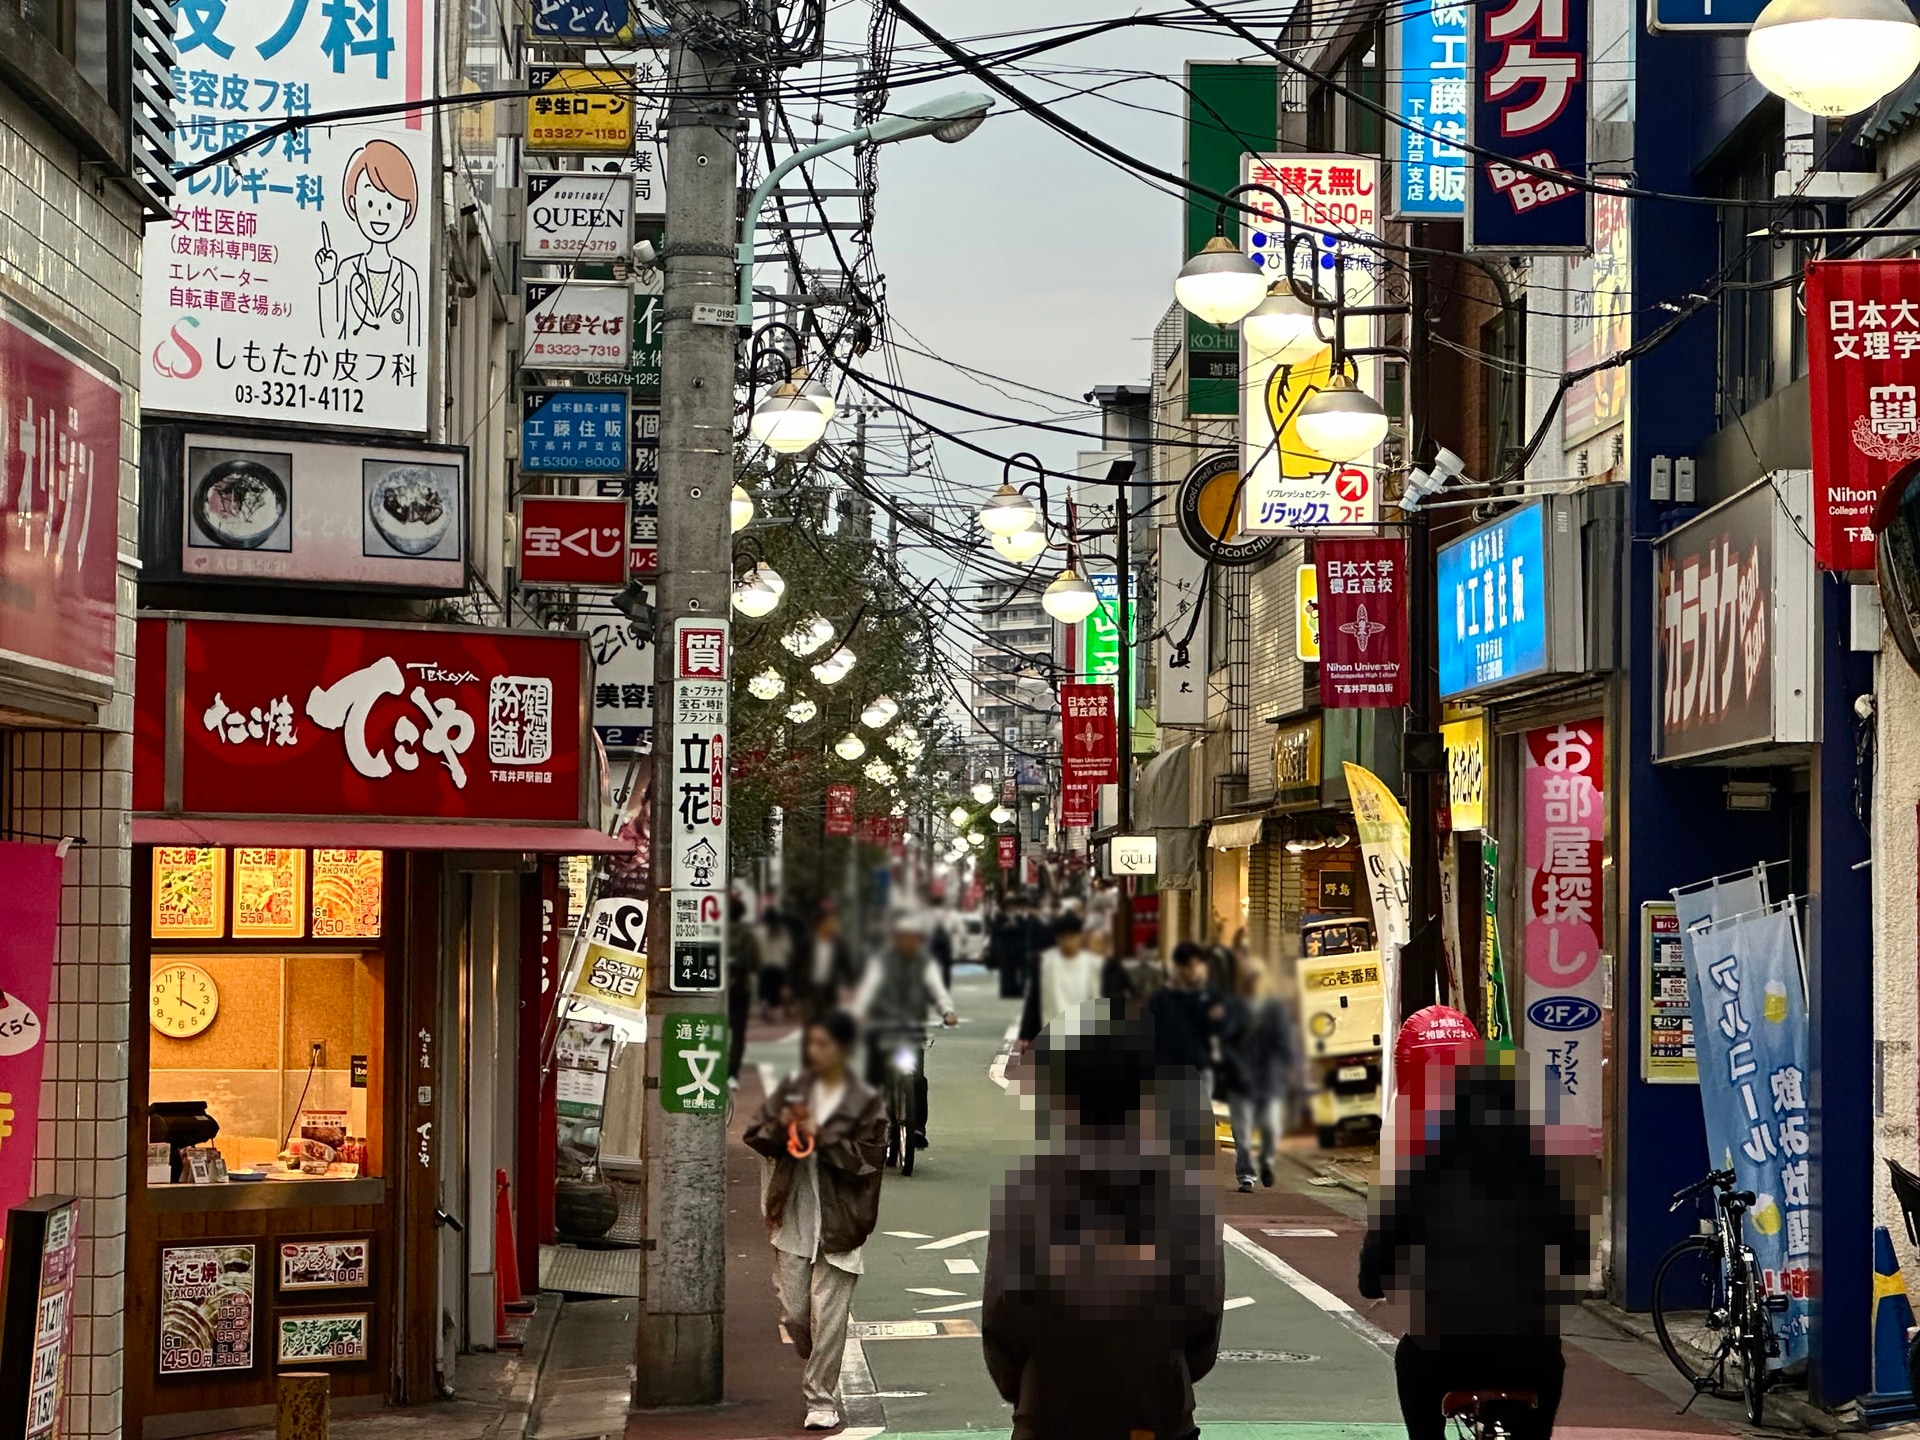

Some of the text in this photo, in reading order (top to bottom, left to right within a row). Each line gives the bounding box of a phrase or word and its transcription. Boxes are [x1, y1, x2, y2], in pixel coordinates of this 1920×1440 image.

[532, 72, 550, 84] 2F
[535, 97, 626, 116] 学生ローン
[531, 179, 547, 192] 1F
[555, 190, 605, 200] BOUTIQUE
[172, 205, 257, 237] 女性医師
[533, 207, 625, 232] QUEEN
[553, 239, 617, 251] 3325-3719
[169, 264, 269, 285] エレベーター
[529, 288, 546, 300] 1F
[547, 344, 621, 356] 3323-7319
[215, 337, 417, 388] しもたか皮フ科
[235, 381, 364, 413] 03-3321-4112
[527, 396, 544, 408] 1F
[528, 420, 622, 438] 工藤住販
[529, 440, 622, 452] 下高井戸支店
[543, 456, 620, 467] 5300-8000
[1828, 487, 1877, 502] Nihon
[1260, 502, 1330, 524] リラックス
[1829, 505, 1858, 517] College
[525, 527, 621, 557] 宝くじ
[1327, 560, 1394, 577] 日本大学
[1664, 540, 1739, 727] カラオケ
[687, 634, 721, 674] 質
[1326, 662, 1352, 672] Nihon
[596, 684, 654, 710] 美容
[1067, 696, 1109, 708] 日本大学
[679, 733, 710, 826] 立花
[159, 849, 197, 865] たこ焼
[239, 850, 277, 865] たこ焼
[1542, 723, 1593, 974] お部屋探し
[1544, 1005, 1570, 1023] 2F
[676, 1023, 723, 1041] 通学
[168, 1261, 218, 1285] たこ焼
[168, 1286, 217, 1299] TAKOYAKI
[164, 1349, 213, 1369] 450円
